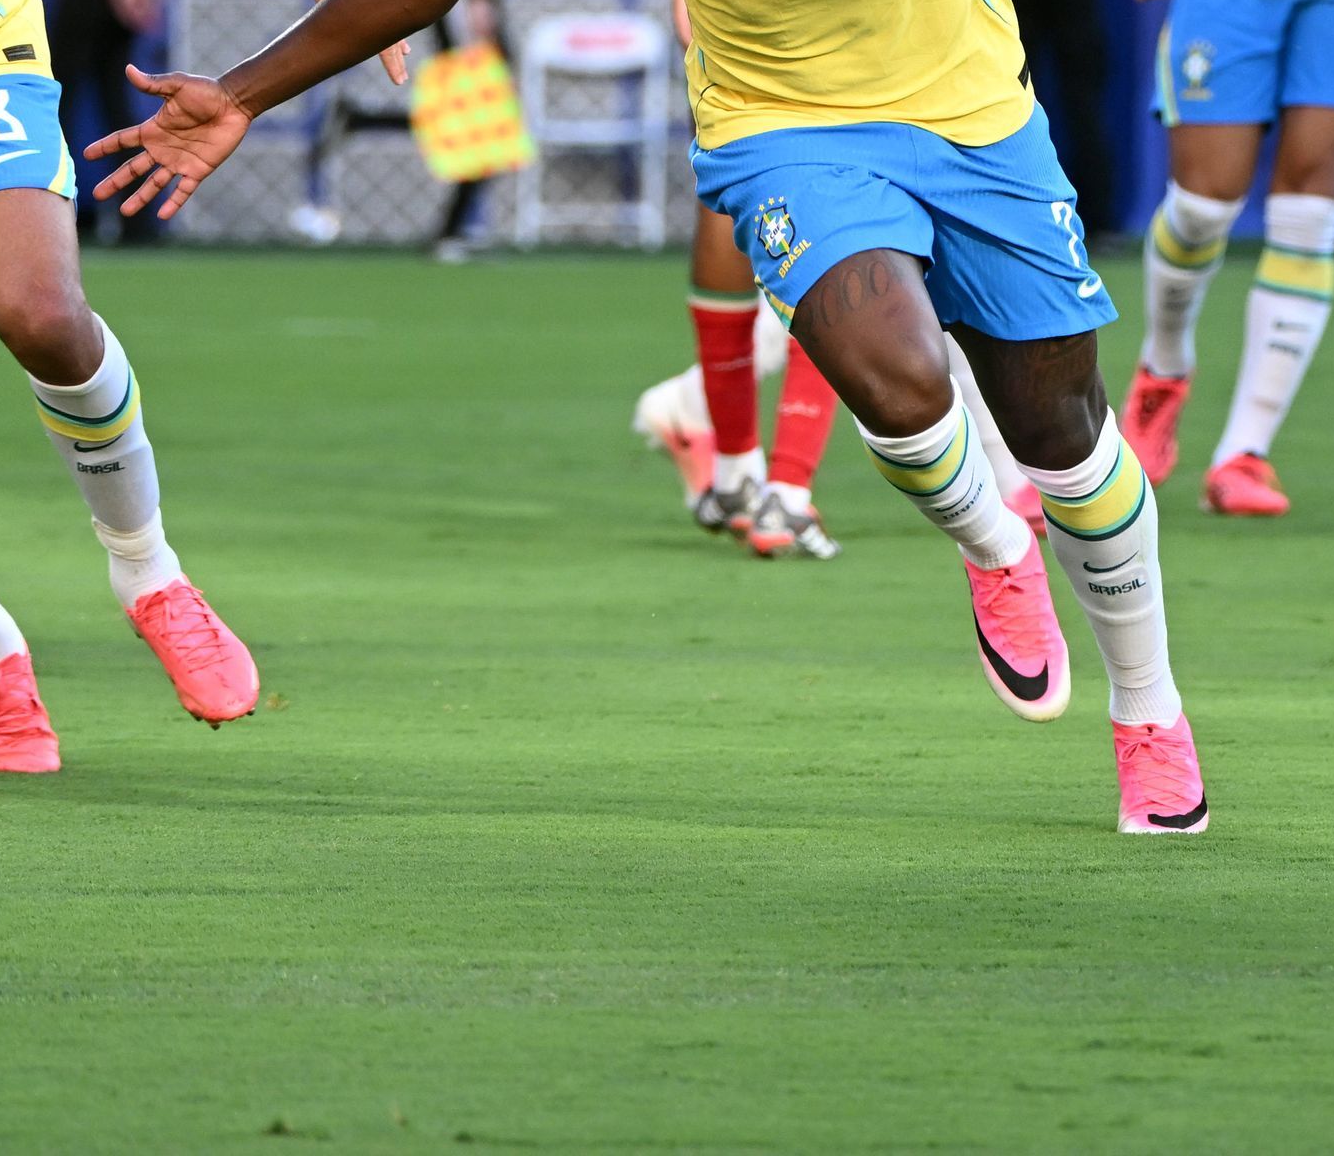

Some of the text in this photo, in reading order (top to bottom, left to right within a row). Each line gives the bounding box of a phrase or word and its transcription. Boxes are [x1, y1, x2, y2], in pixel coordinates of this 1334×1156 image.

[778, 239, 812, 279] BRASIL
[77, 461, 125, 474] BRASIL
[1088, 578, 1146, 596] BRASIL
